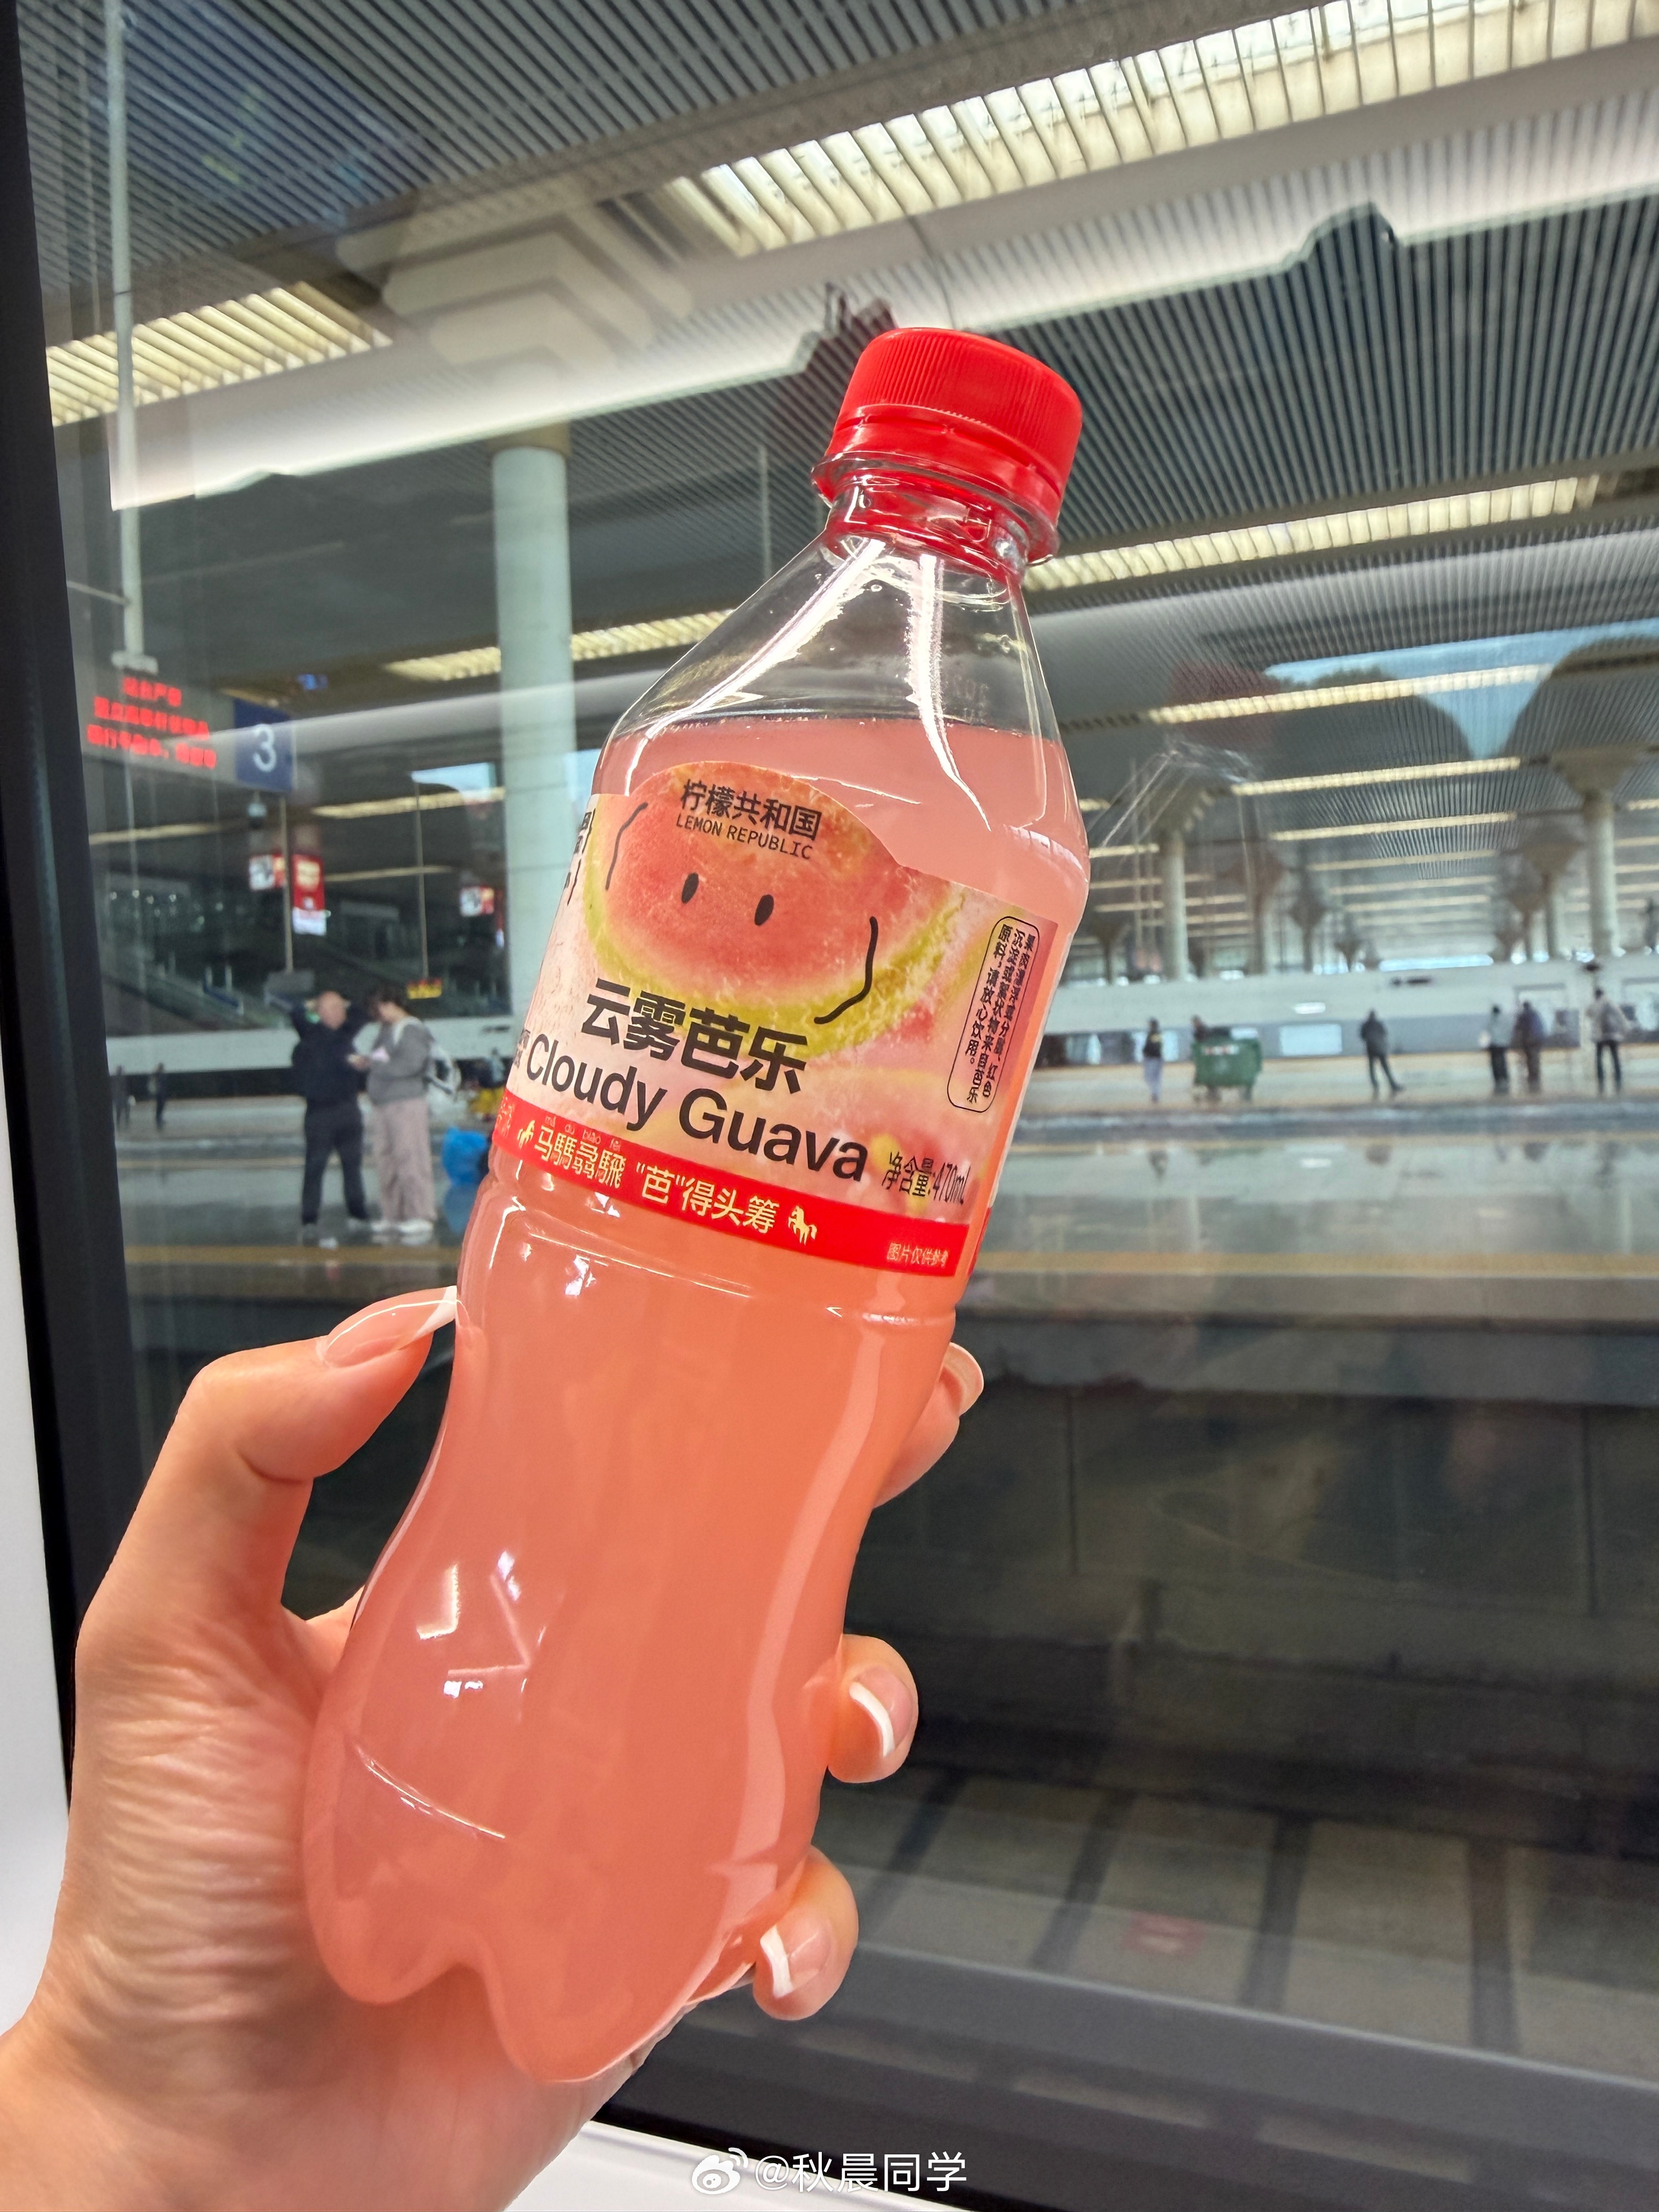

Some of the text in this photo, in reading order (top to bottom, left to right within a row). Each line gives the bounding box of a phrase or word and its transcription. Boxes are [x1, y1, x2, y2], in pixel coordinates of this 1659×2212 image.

[253, 724, 276, 772] 3
[676, 812, 813, 860] LEMON REPUBLIC
[680, 779, 822, 841] 柠檬共和国
[581, 978, 809, 1094] 云雾芭乐
[527, 1034, 667, 1131] Cloudy
[679, 1088, 868, 1182] Guava
